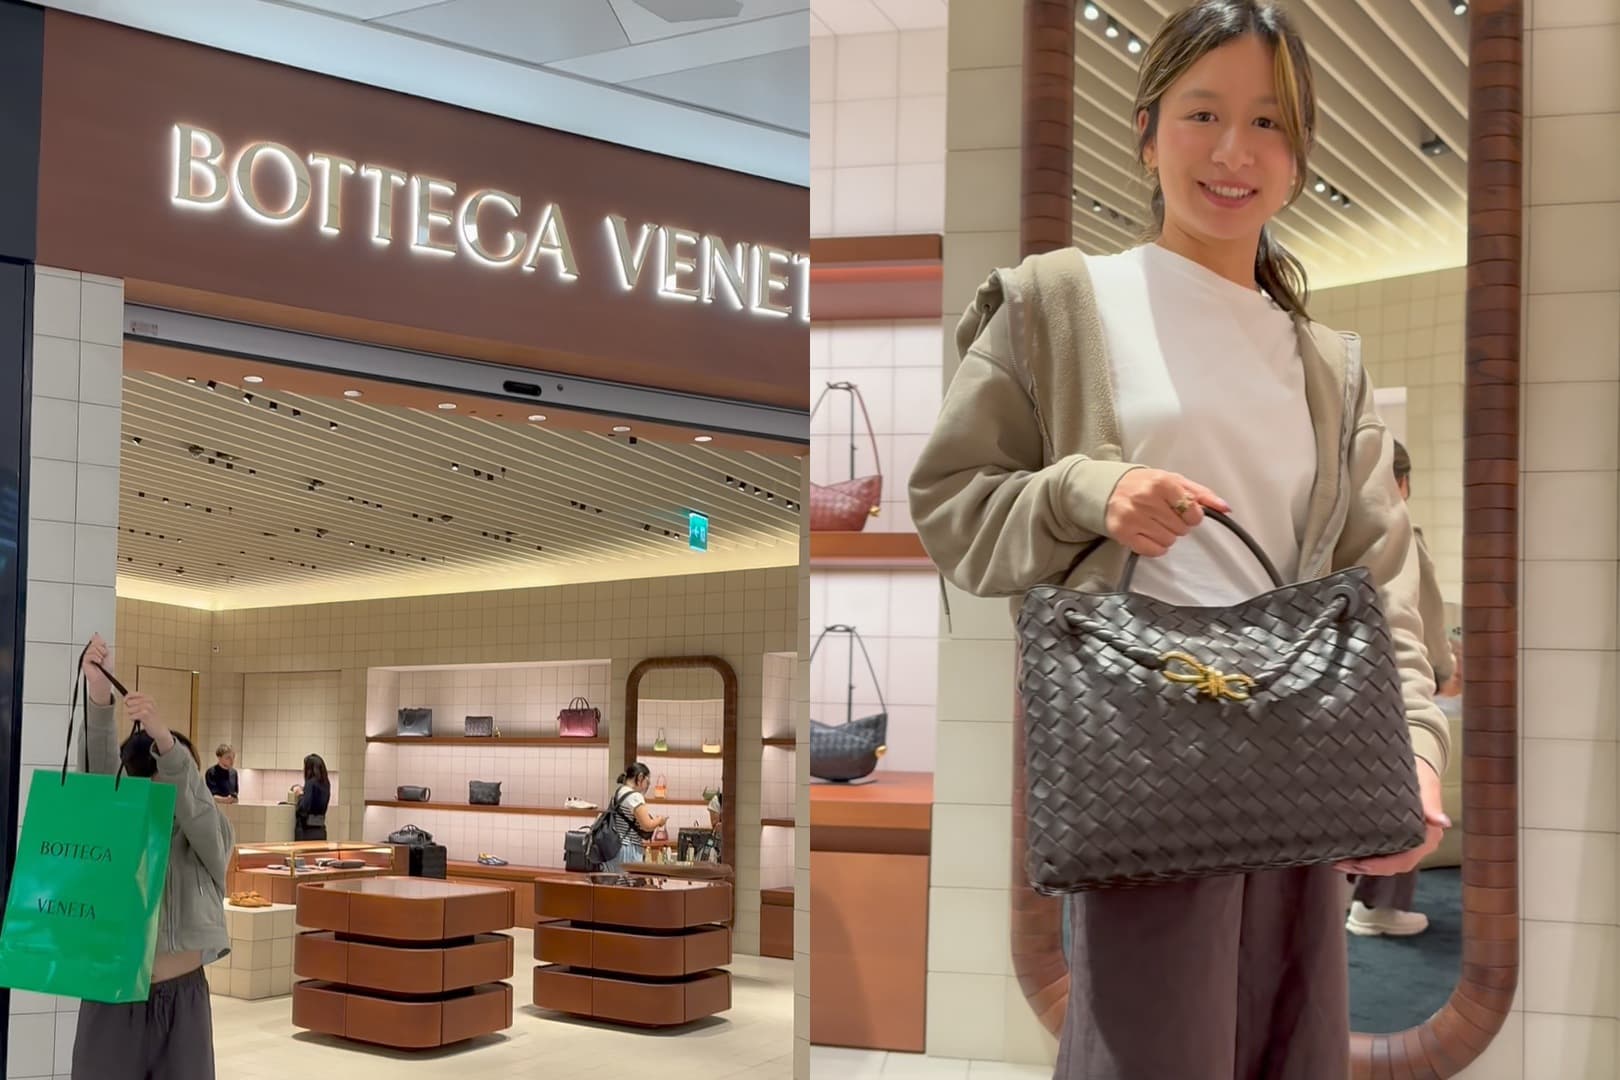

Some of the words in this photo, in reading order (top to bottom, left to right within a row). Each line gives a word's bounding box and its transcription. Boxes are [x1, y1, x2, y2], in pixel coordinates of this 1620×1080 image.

[172, 122, 580, 280] BOTTEGA
[41, 841, 112, 862] BOTTEGA
[38, 898, 96, 919] VENETA
